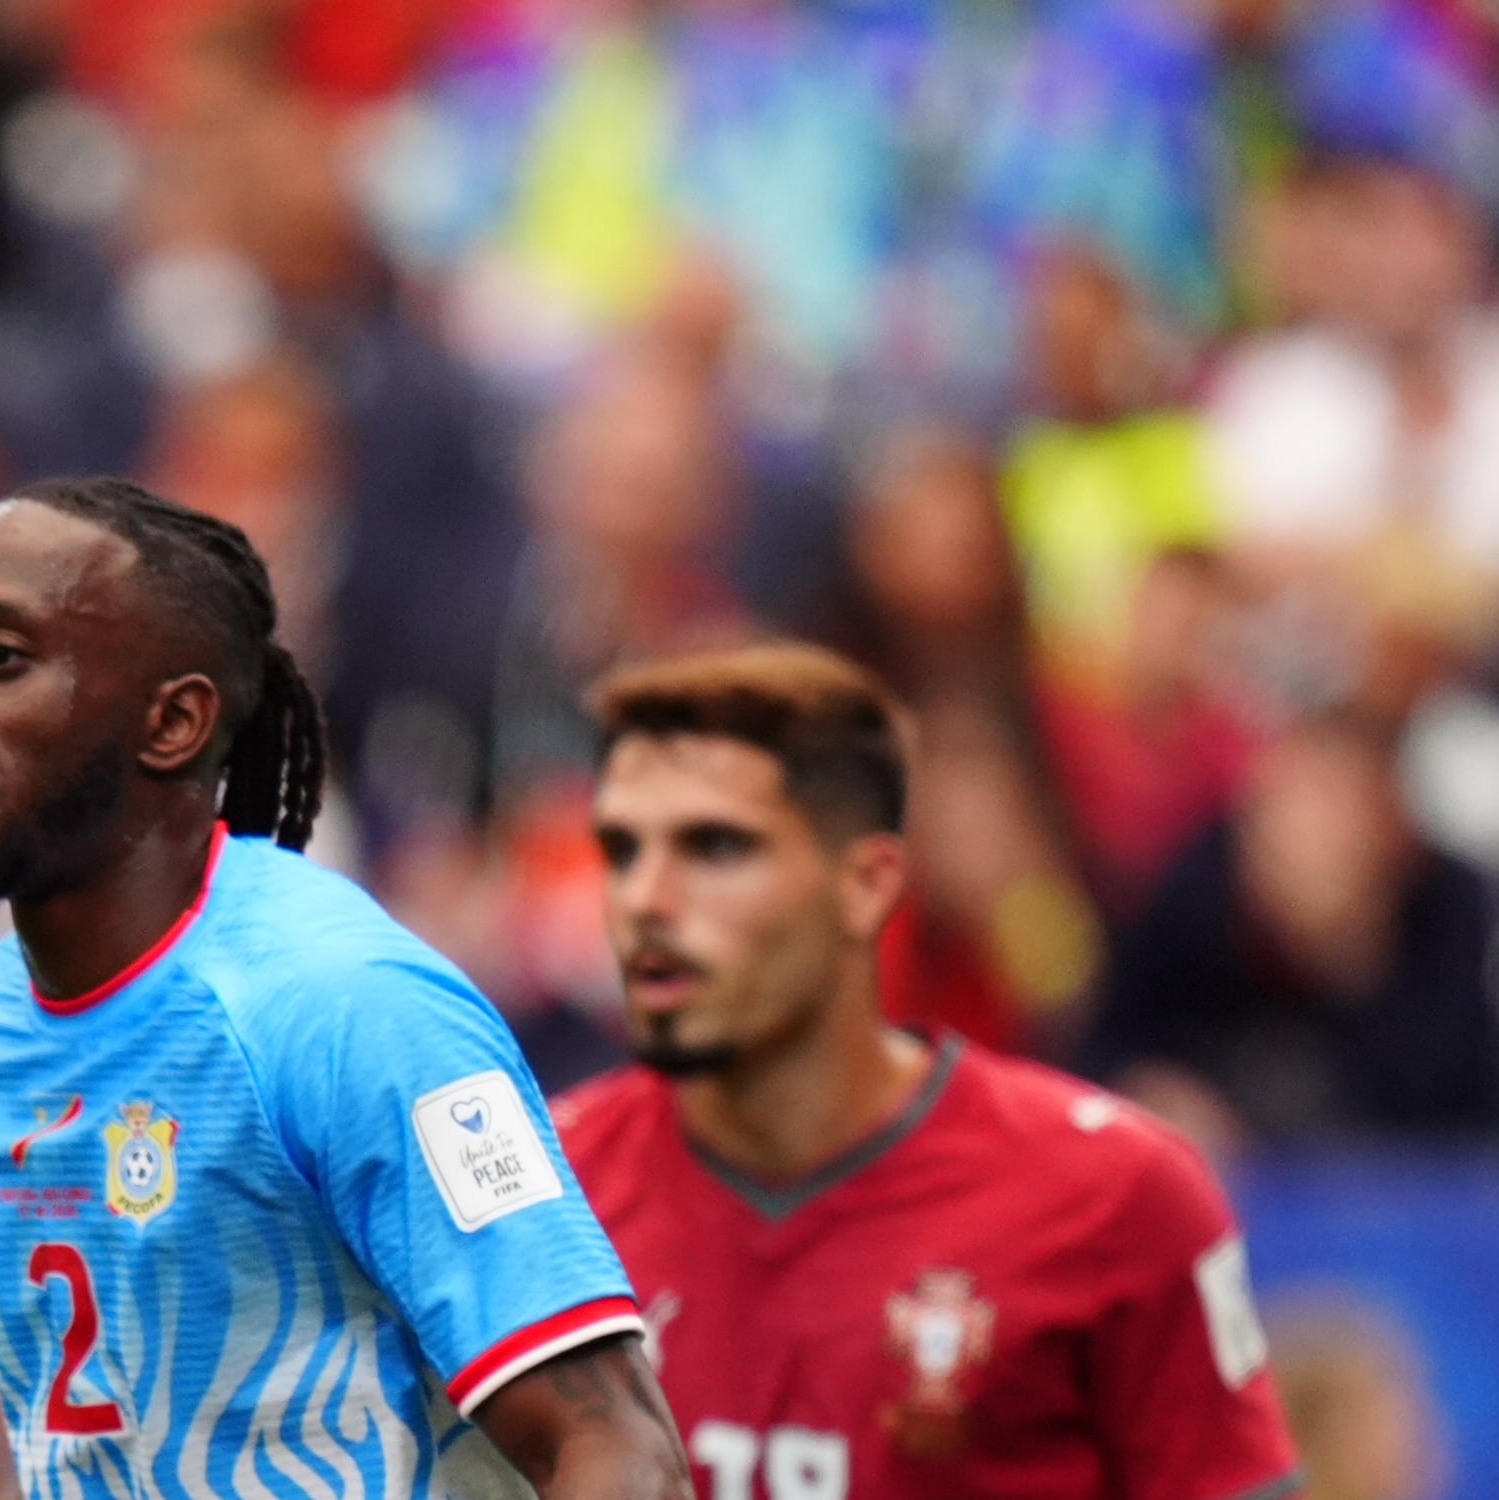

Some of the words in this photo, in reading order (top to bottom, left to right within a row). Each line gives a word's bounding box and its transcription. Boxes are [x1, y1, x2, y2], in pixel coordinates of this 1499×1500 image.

[473, 1154, 526, 1189] PEACE
[493, 1181, 523, 1198] FIFA
[26, 1241, 125, 1436] 2
